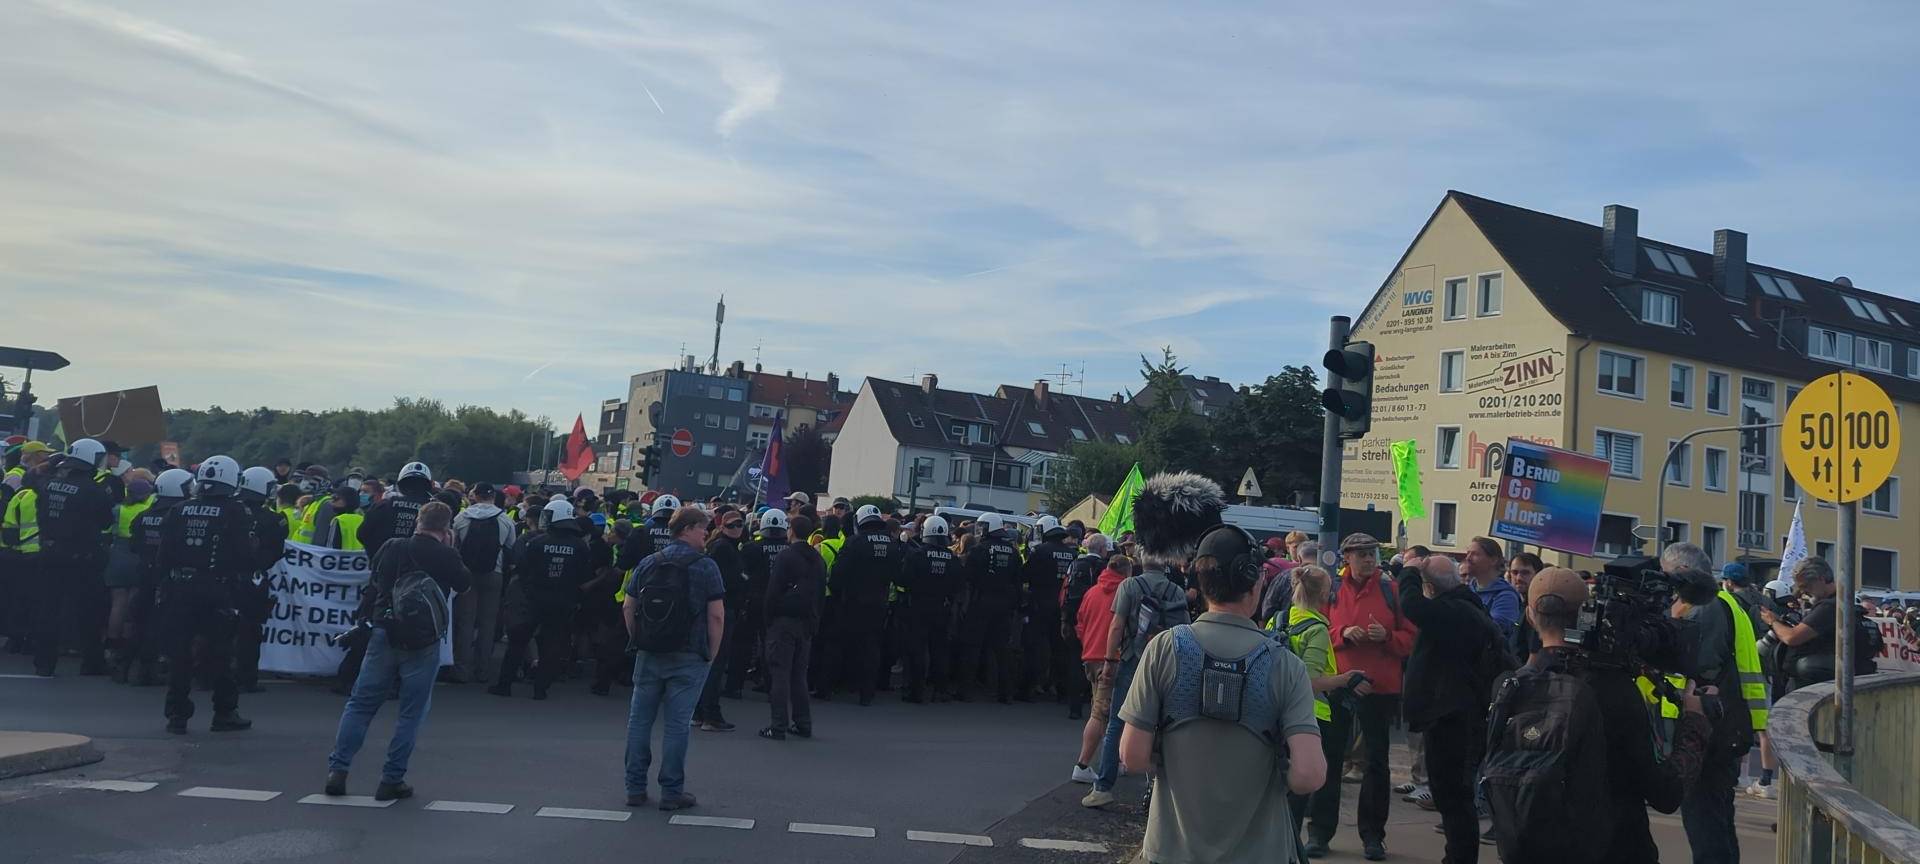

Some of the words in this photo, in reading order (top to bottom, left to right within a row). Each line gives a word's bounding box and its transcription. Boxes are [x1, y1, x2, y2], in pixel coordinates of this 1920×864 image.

[1404, 290, 1433, 305] WVG
[1402, 307, 1433, 317] LANGNER
[1470, 343, 1516, 352] Malerarbeiten
[1503, 355, 1553, 386] ZINN
[1375, 383, 1429, 393] Bedachungen
[1468, 376, 1504, 389] Malerbetrieb
[1479, 395, 1536, 408] 0201/210
[1539, 393, 1562, 406] 200
[1468, 410, 1561, 419] www.malerbetrieb-zinn.de
[1800, 412, 1834, 450] 50
[1844, 410, 1890, 449] 100
[1361, 436, 1391, 449] parkett
[1361, 449, 1391, 461] strehl
[1511, 457, 1561, 483] BERND
[48, 482, 79, 494] POLIZEI
[1469, 481, 1500, 490] Alfre
[1508, 478, 1532, 500] GO
[181, 505, 220, 517] POLIZEI
[142, 516, 162, 526] POLIZ
[649, 527, 672, 536] POLIZ
[544, 544, 573, 555] POLIZEI
[927, 550, 952, 560] POLIZEI
[284, 548, 314, 568] ER
[320, 554, 371, 572] GEG
[268, 569, 350, 600] KÄMPFT
[357, 585, 368, 600] K
[270, 602, 303, 621] UF
[261, 625, 321, 647] NICHT
